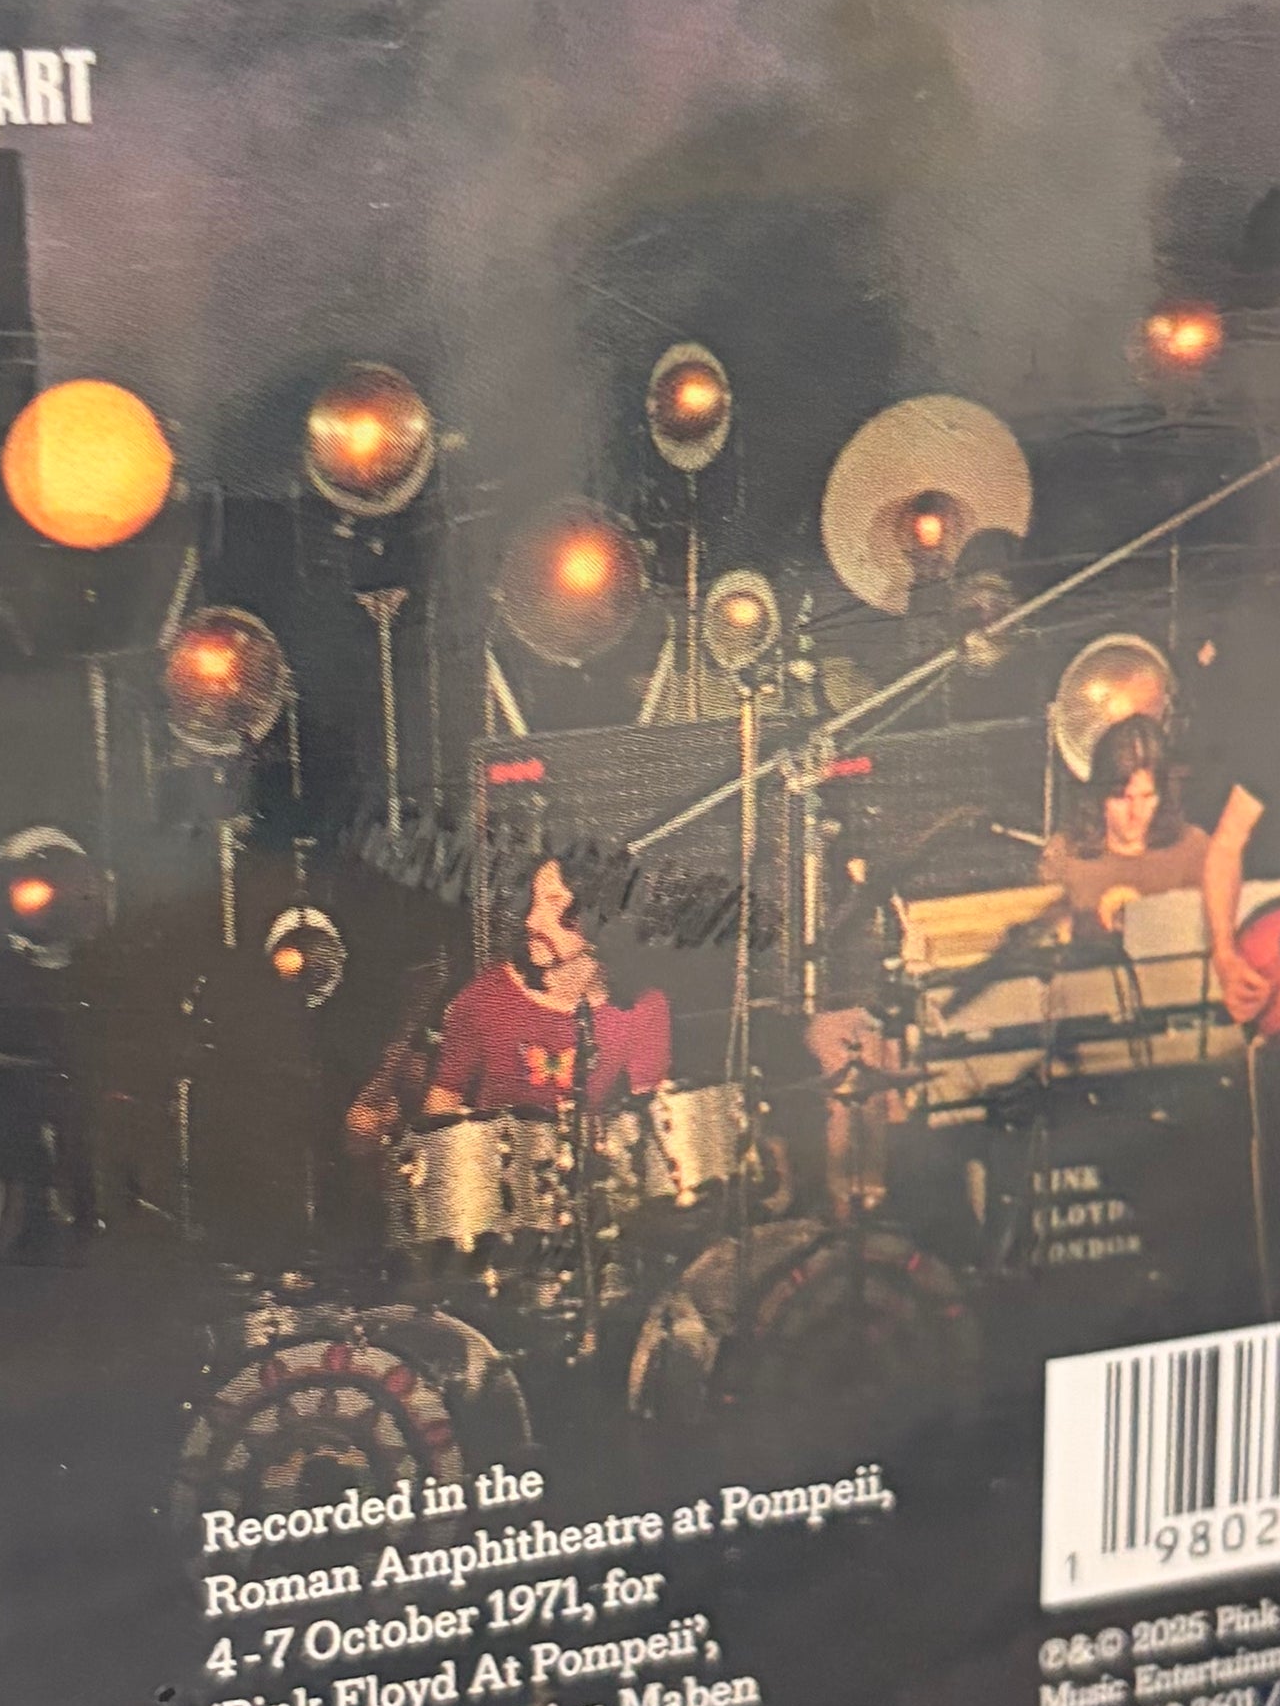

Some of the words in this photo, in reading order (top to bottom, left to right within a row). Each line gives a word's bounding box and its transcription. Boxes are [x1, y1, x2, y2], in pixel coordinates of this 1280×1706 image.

[203, 1480, 415, 1552] Recorded
[423, 1477, 466, 1515] in
[475, 1465, 543, 1506] the
[204, 1566, 361, 1616] Roman
[371, 1513, 662, 1587] Amphitheatre
[673, 1500, 712, 1535] at
[721, 1465, 893, 1526] Pompeii,
[1063, 1550, 1081, 1584] 1
[305, 1605, 479, 1660] October
[488, 1577, 594, 1628] 1971,
[603, 1568, 663, 1608] for
[1133, 1610, 1210, 1653] 2025
[468, 1654, 521, 1694] At
